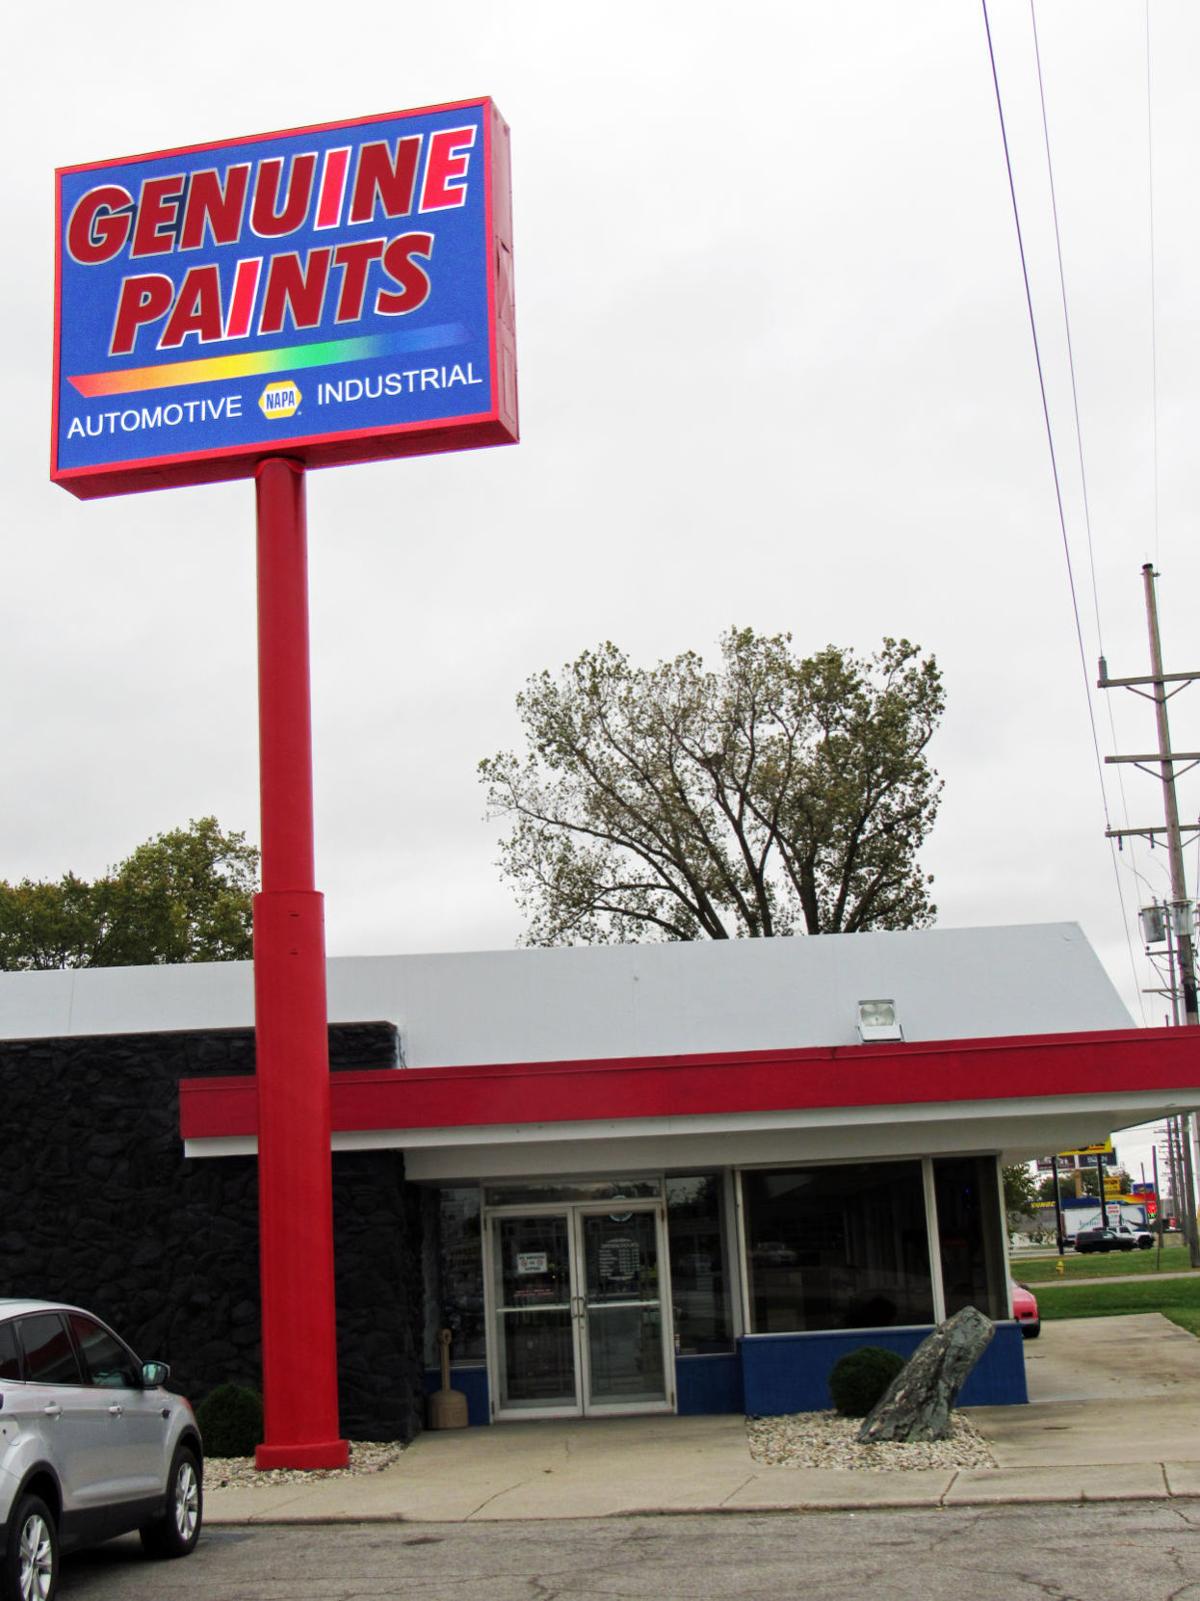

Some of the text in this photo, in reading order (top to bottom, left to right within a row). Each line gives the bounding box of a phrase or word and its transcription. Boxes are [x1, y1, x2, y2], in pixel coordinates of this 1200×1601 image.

[66, 125, 477, 265] GENUINE
[108, 231, 434, 356] PAINTS
[67, 363, 482, 438] AUTOMOTIVE NAPA INDUSTRIAL
